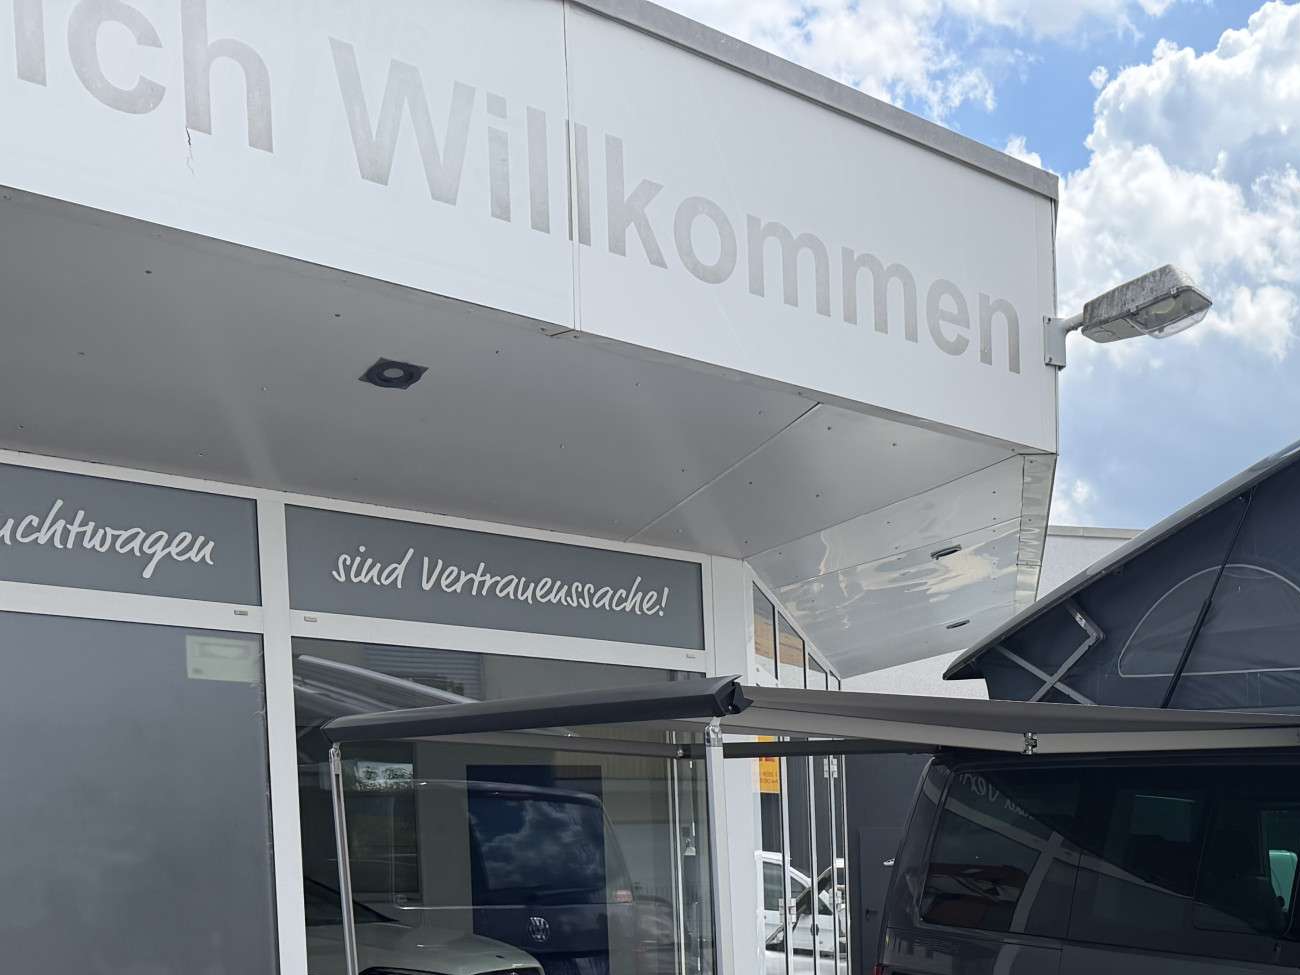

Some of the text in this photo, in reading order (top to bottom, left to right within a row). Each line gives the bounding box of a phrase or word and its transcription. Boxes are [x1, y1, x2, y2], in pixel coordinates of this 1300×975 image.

[327, 35, 1021, 375] Willkommen
[331, 545, 670, 617] sind Vertrauenssache!
